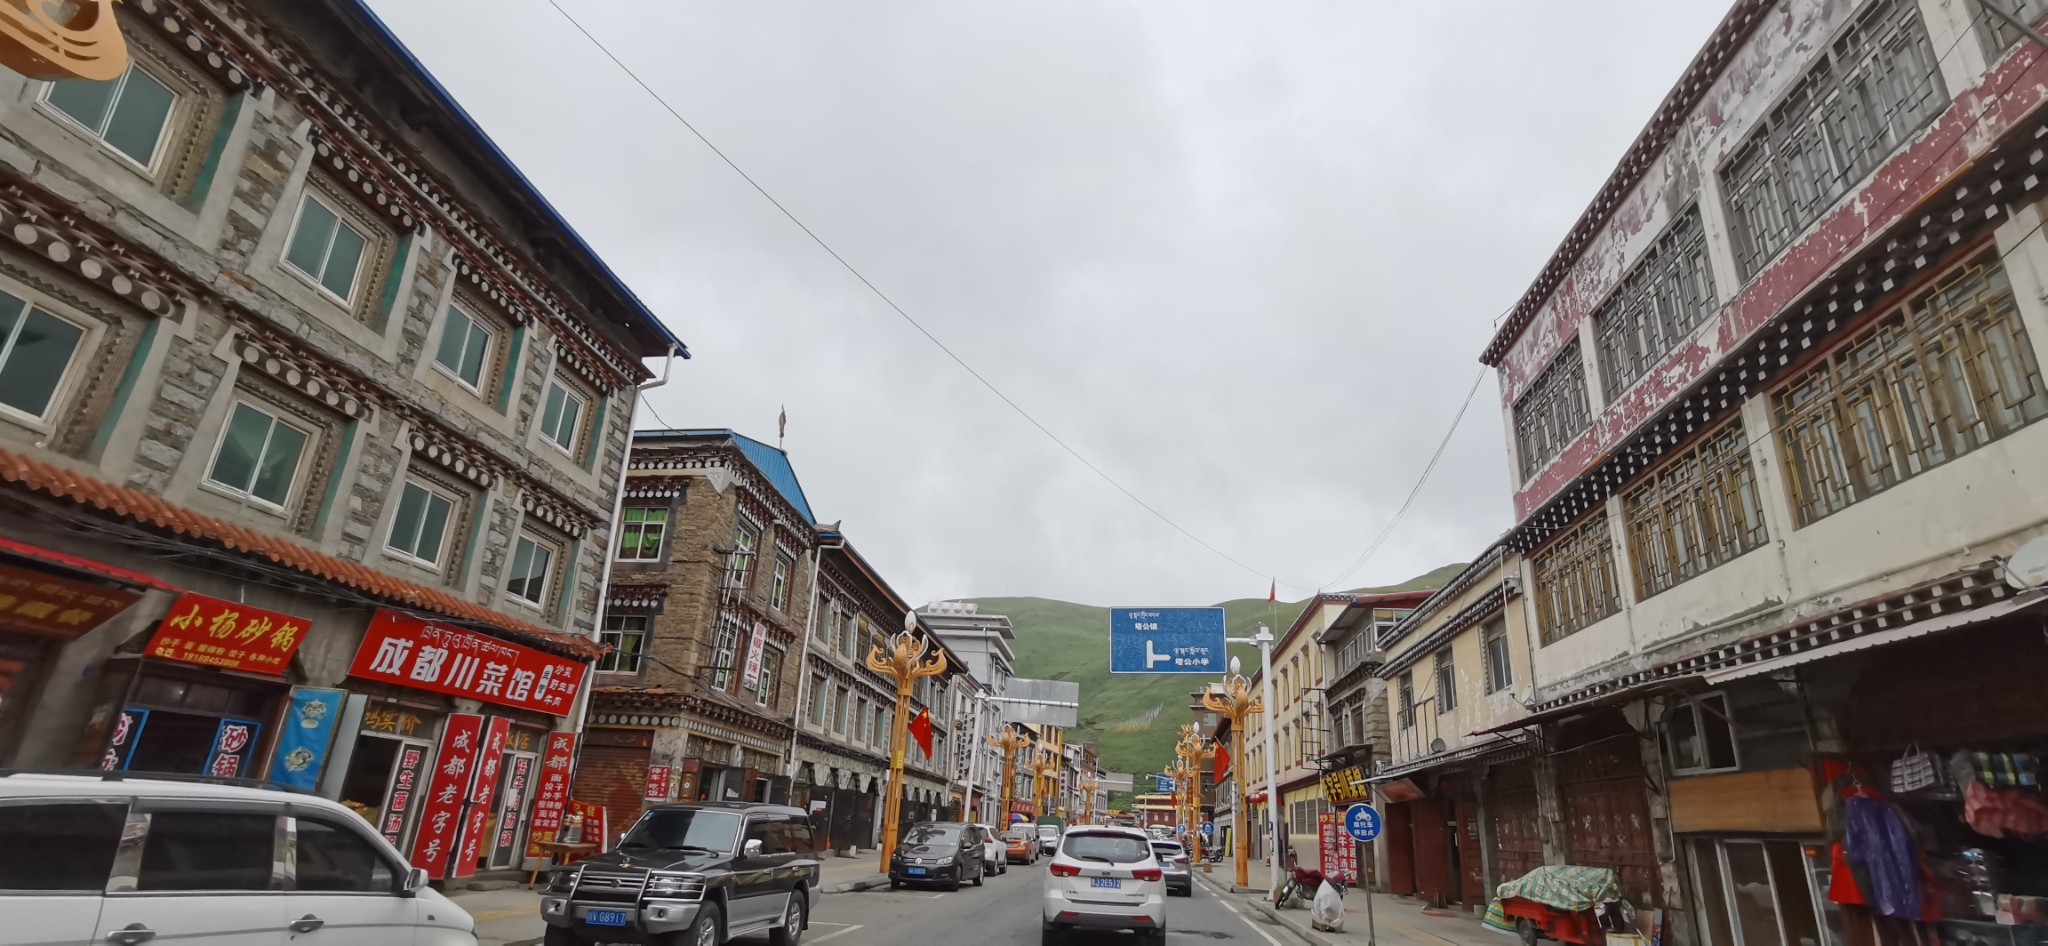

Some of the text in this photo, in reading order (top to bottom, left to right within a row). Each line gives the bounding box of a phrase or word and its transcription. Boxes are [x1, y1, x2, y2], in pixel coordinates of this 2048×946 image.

[169, 603, 299, 652] 小杨砂锅
[1134, 622, 1158, 631] 塔公镇
[1174, 657, 1210, 666] 塔公小学
[369, 637, 536, 702] 成都川菜馆
[554, 664, 573, 678] 炒菜
[549, 678, 576, 694] 野生菌
[544, 694, 562, 707] 牛肉
[212, 724, 249, 778] 砂锅
[545, 737, 569, 771] 成都
[550, 773, 562, 782] 面
[544, 782, 565, 792] 饺子
[423, 729, 472, 863] 成都老字号
[464, 733, 501, 862] 成都老字号
[542, 791, 562, 801] 抄手
[538, 809, 558, 819] 面块
[533, 818, 558, 828] 家常菜
[1353, 821, 1374, 829] 摩托车
[531, 830, 555, 843] 炒菜
[1353, 829, 1375, 837] 停放点
[528, 843, 552, 855] 汤
